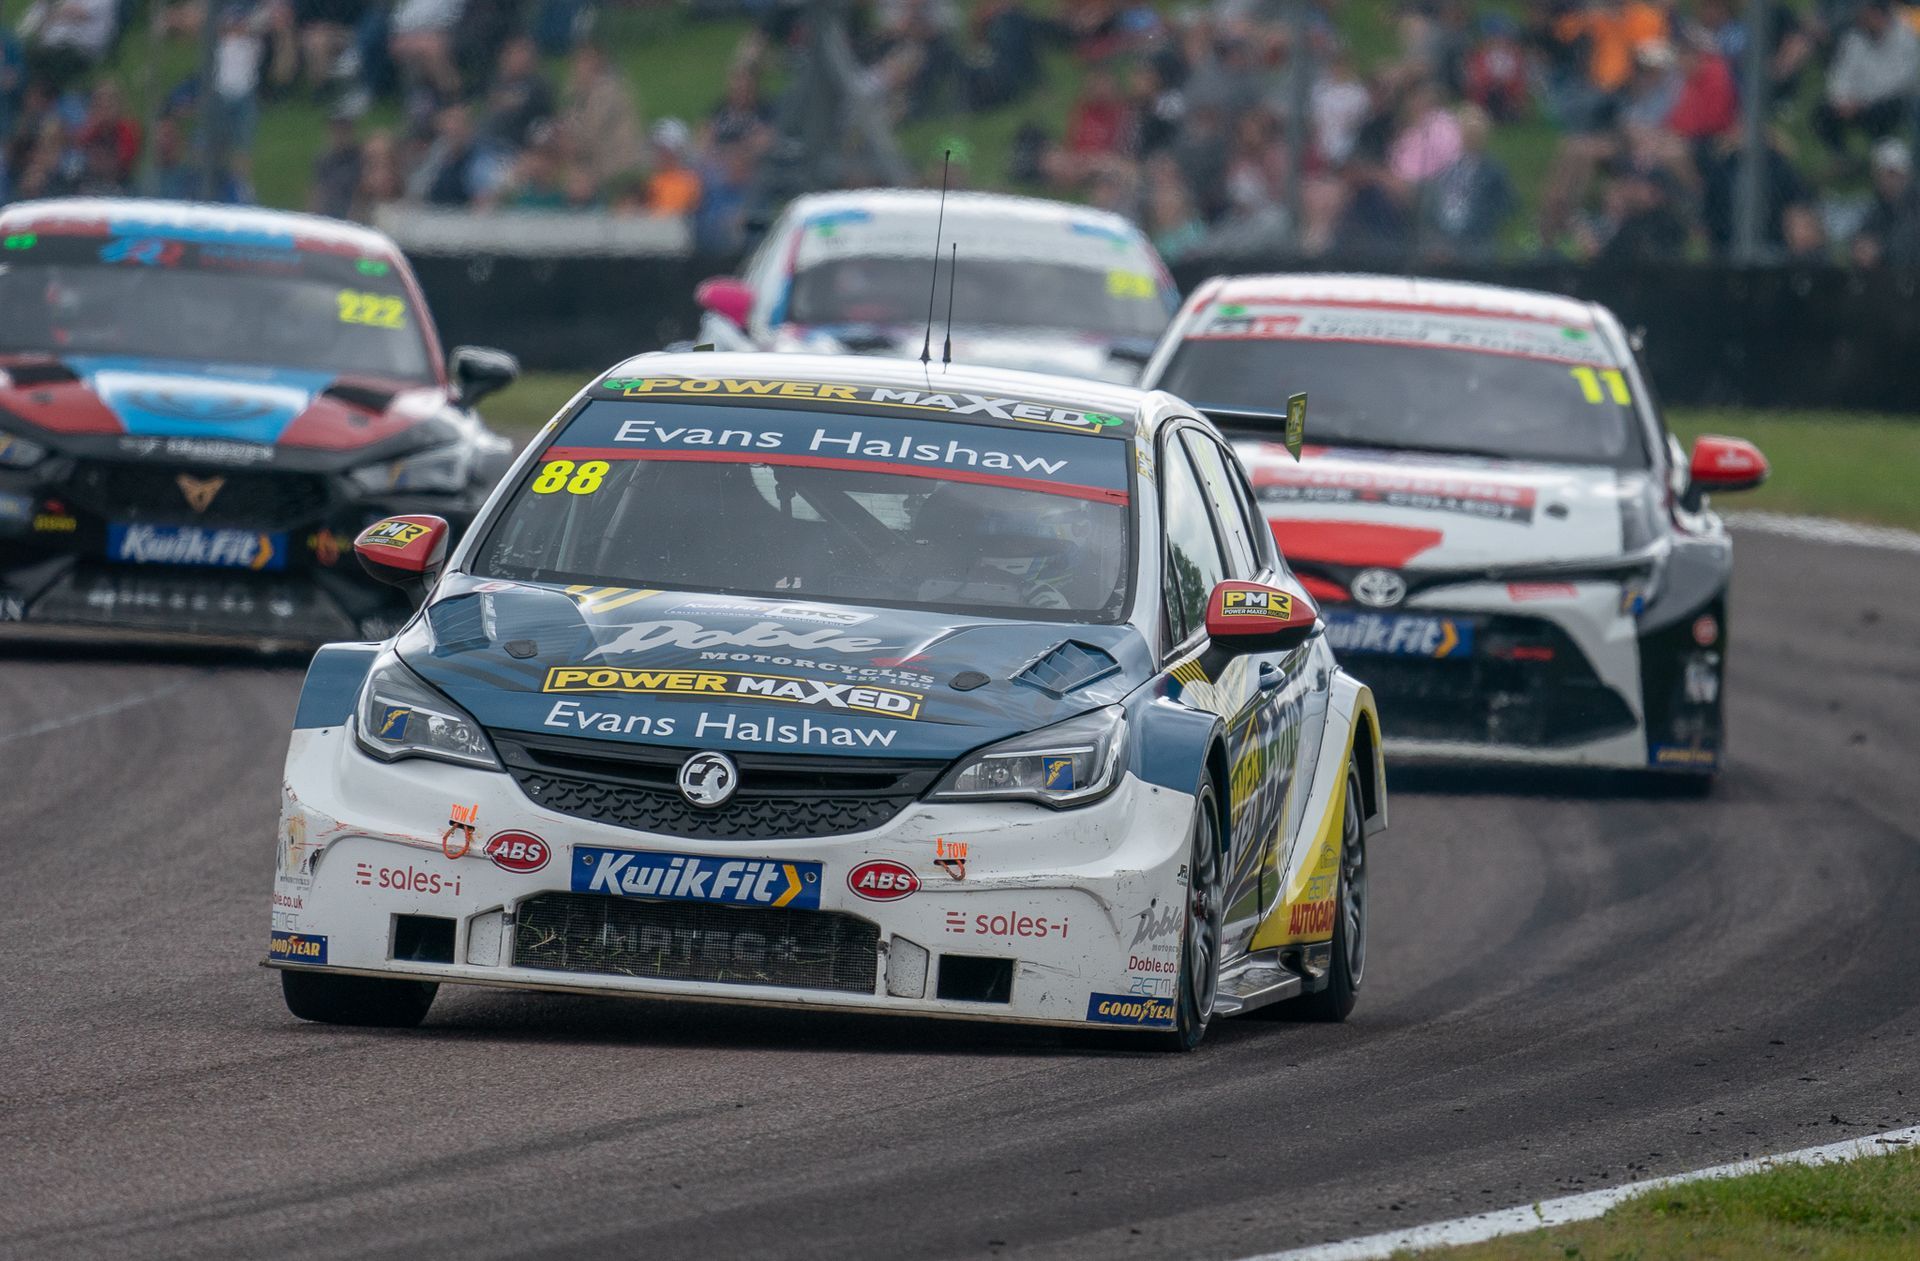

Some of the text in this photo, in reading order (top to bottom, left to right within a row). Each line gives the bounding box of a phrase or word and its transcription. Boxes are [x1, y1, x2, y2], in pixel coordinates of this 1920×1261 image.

[338, 289, 405, 329] 222
[640, 379, 1089, 425] POWER MAXED
[1571, 367, 1632, 405] 11
[614, 420, 1068, 475] Evans Halshaw
[532, 460, 611, 495] 88
[368, 521, 424, 539] PMR
[1226, 592, 1289, 609] PMR
[568, 620, 904, 662] Doble
[1325, 612, 1442, 654] wikFit
[700, 651, 936, 684] MOTORCYCLES
[554, 671, 912, 713] POWER MAXED
[544, 701, 898, 748] Evans Halshaw
[451, 804, 470, 823] TOW
[495, 841, 542, 862] ABS
[947, 842, 968, 858] TOW
[379, 865, 461, 896] sales-i
[859, 871, 911, 891] ABS
[975, 911, 1069, 938] sales-i
[272, 938, 321, 957] OODYEAR
[1129, 956, 1177, 974] Doble.co.
